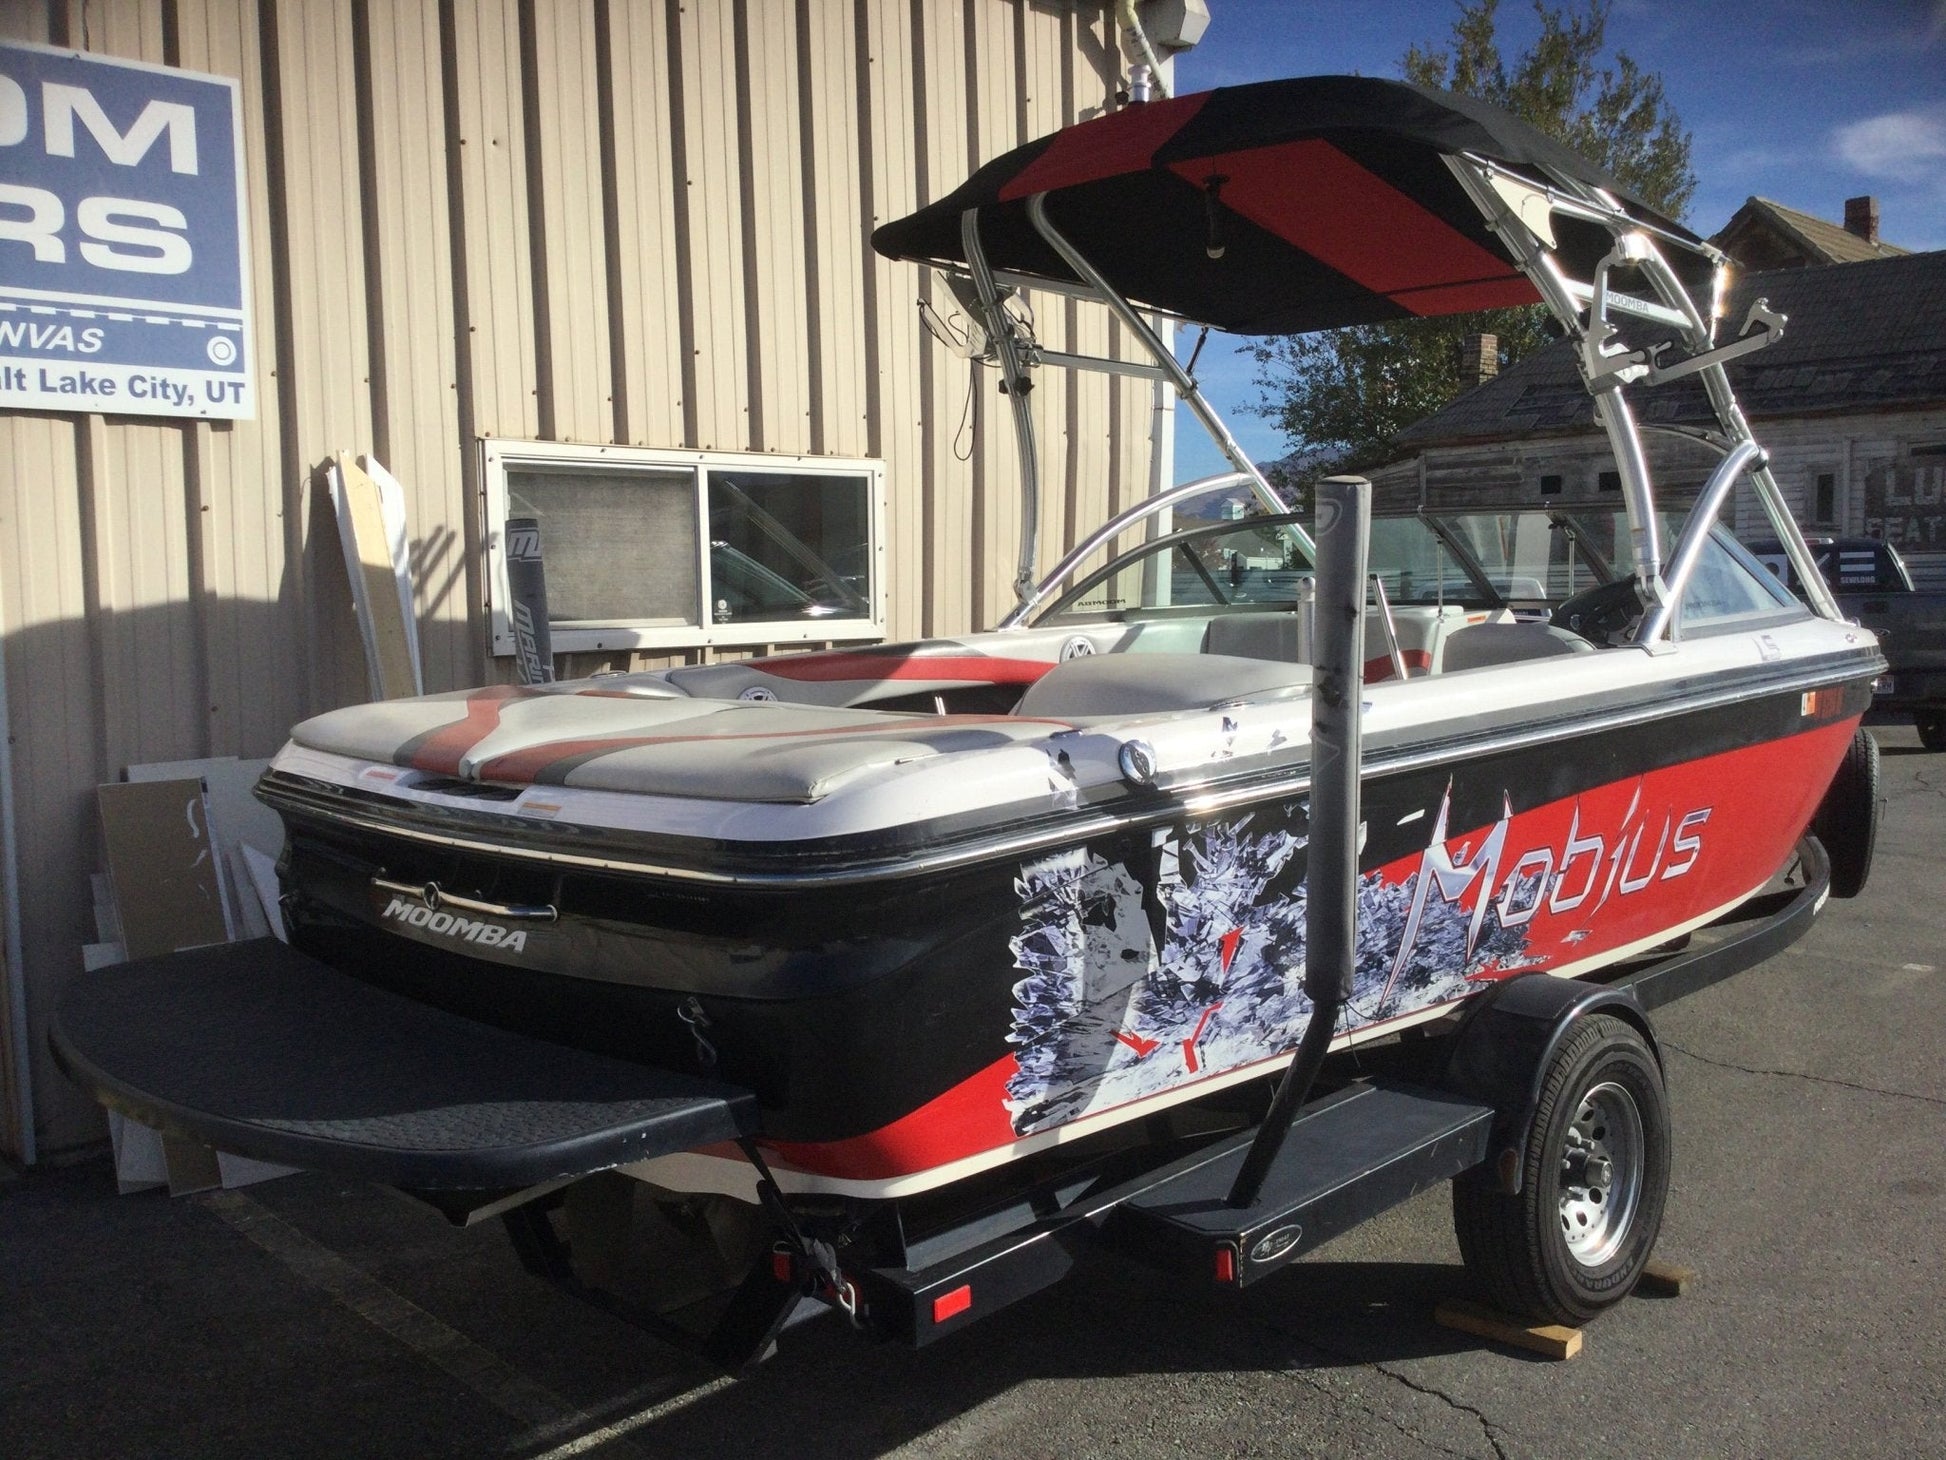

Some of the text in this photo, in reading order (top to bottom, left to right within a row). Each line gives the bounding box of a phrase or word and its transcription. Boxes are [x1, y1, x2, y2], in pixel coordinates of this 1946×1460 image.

[0, 73, 198, 176] M
[1606, 291, 1650, 313] MOOMBA
[0, 366, 246, 407] lt Lake City, UT
[1885, 466, 1946, 506] LU
[381, 898, 528, 954] MOOMBA
